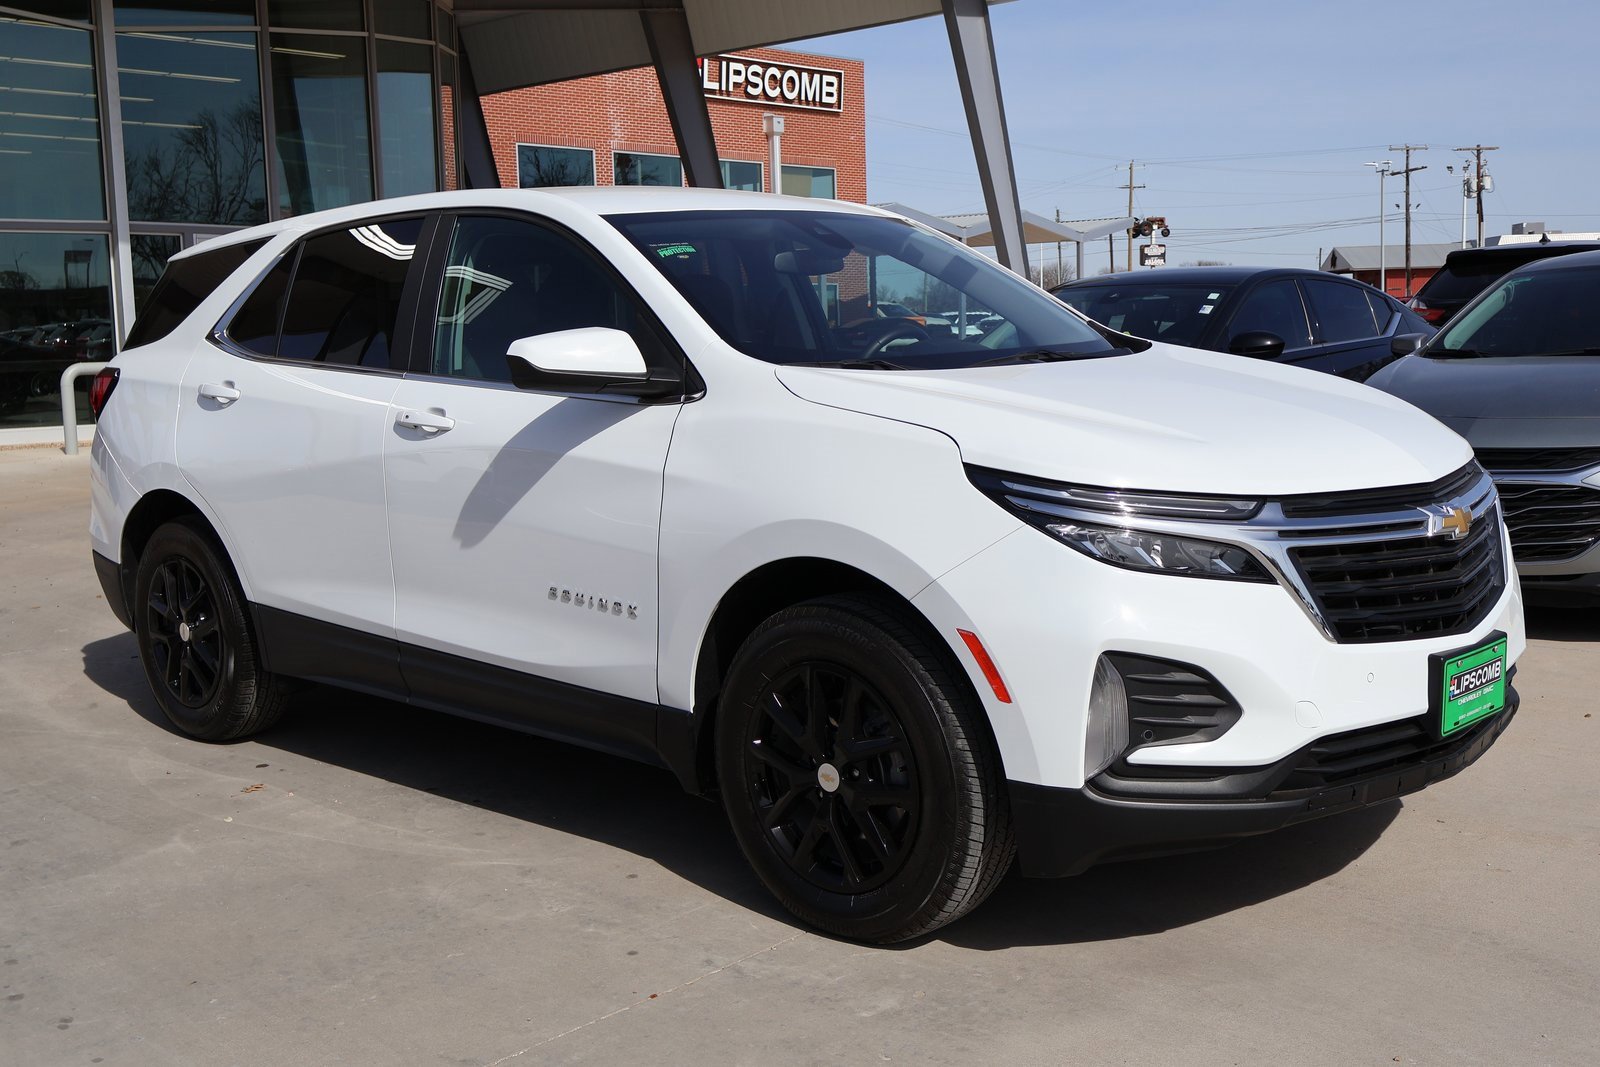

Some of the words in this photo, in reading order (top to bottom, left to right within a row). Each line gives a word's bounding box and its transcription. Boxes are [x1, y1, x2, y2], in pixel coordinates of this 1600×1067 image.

[703, 58, 838, 104] LIPSCOMB
[658, 246, 696, 257] PROTECTION
[547, 586, 638, 620] EQUINOX
[1454, 661, 1501, 694] LIPSCOMB
[1458, 692, 1482, 705] CHEVROLET
[1483, 685, 1494, 695] GMC
